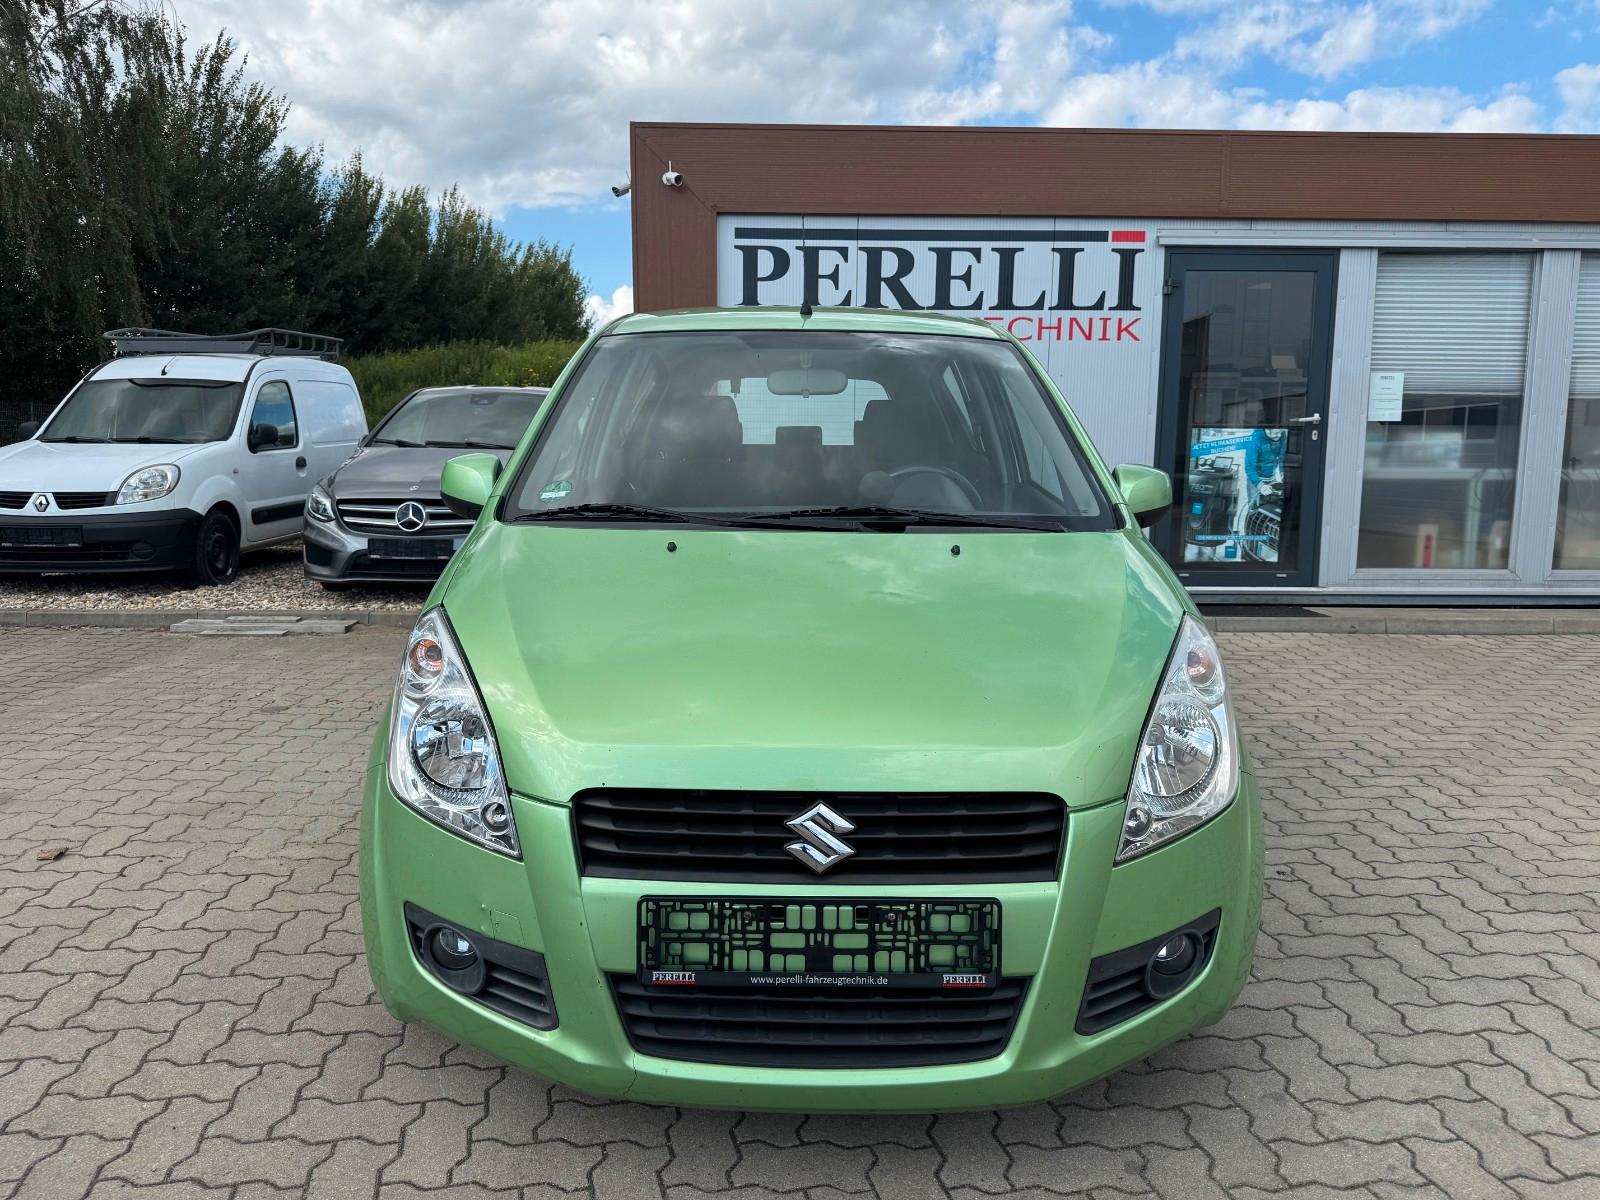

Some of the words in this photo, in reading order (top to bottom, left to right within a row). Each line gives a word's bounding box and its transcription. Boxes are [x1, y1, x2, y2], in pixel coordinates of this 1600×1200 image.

[734, 245, 1146, 311] PERELLI
[983, 316, 1142, 342] CHNIK
[1192, 442, 1210, 450] JETZT
[652, 973, 696, 982] PERELLI
[750, 974, 889, 986] www.perelli-fahrzeugtechnik.de
[943, 975, 986, 984] PERELLI
